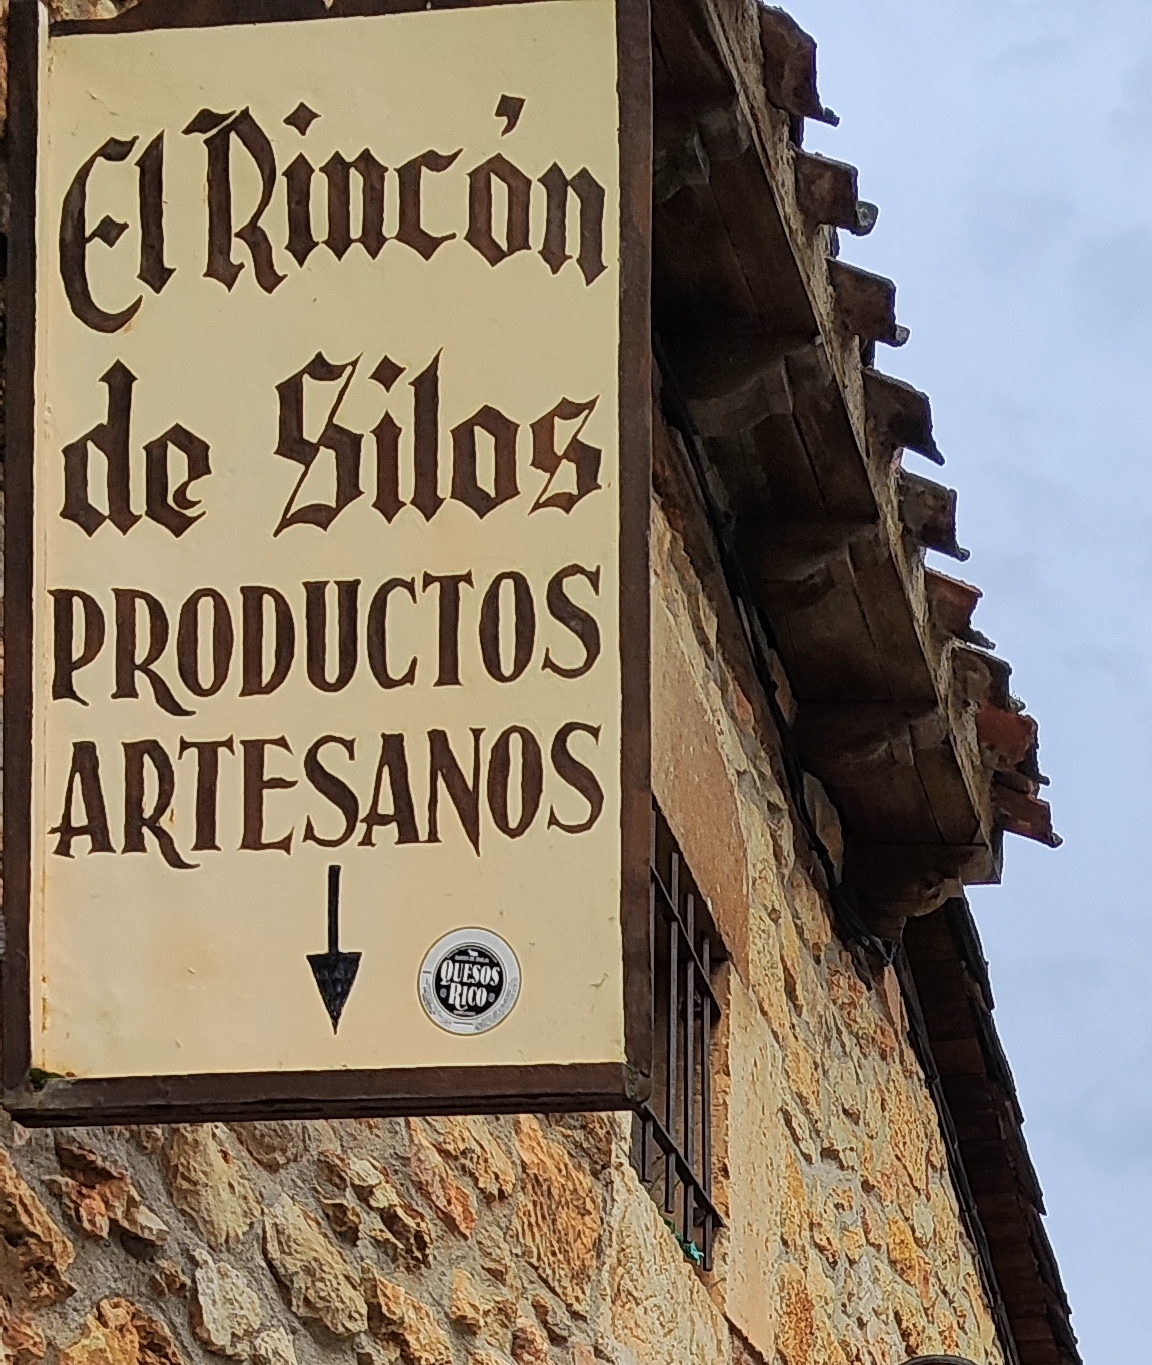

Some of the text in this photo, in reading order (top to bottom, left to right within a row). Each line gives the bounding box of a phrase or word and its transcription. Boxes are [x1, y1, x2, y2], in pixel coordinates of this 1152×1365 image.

[59, 94, 609, 334] El Rincón
[60, 347, 602, 539] de Silos
[47, 563, 602, 717] PRODUCTOS
[50, 721, 605, 869] ARTESANOS
[439, 959, 501, 987] QUESOS
[447, 982, 489, 1011] RICO
